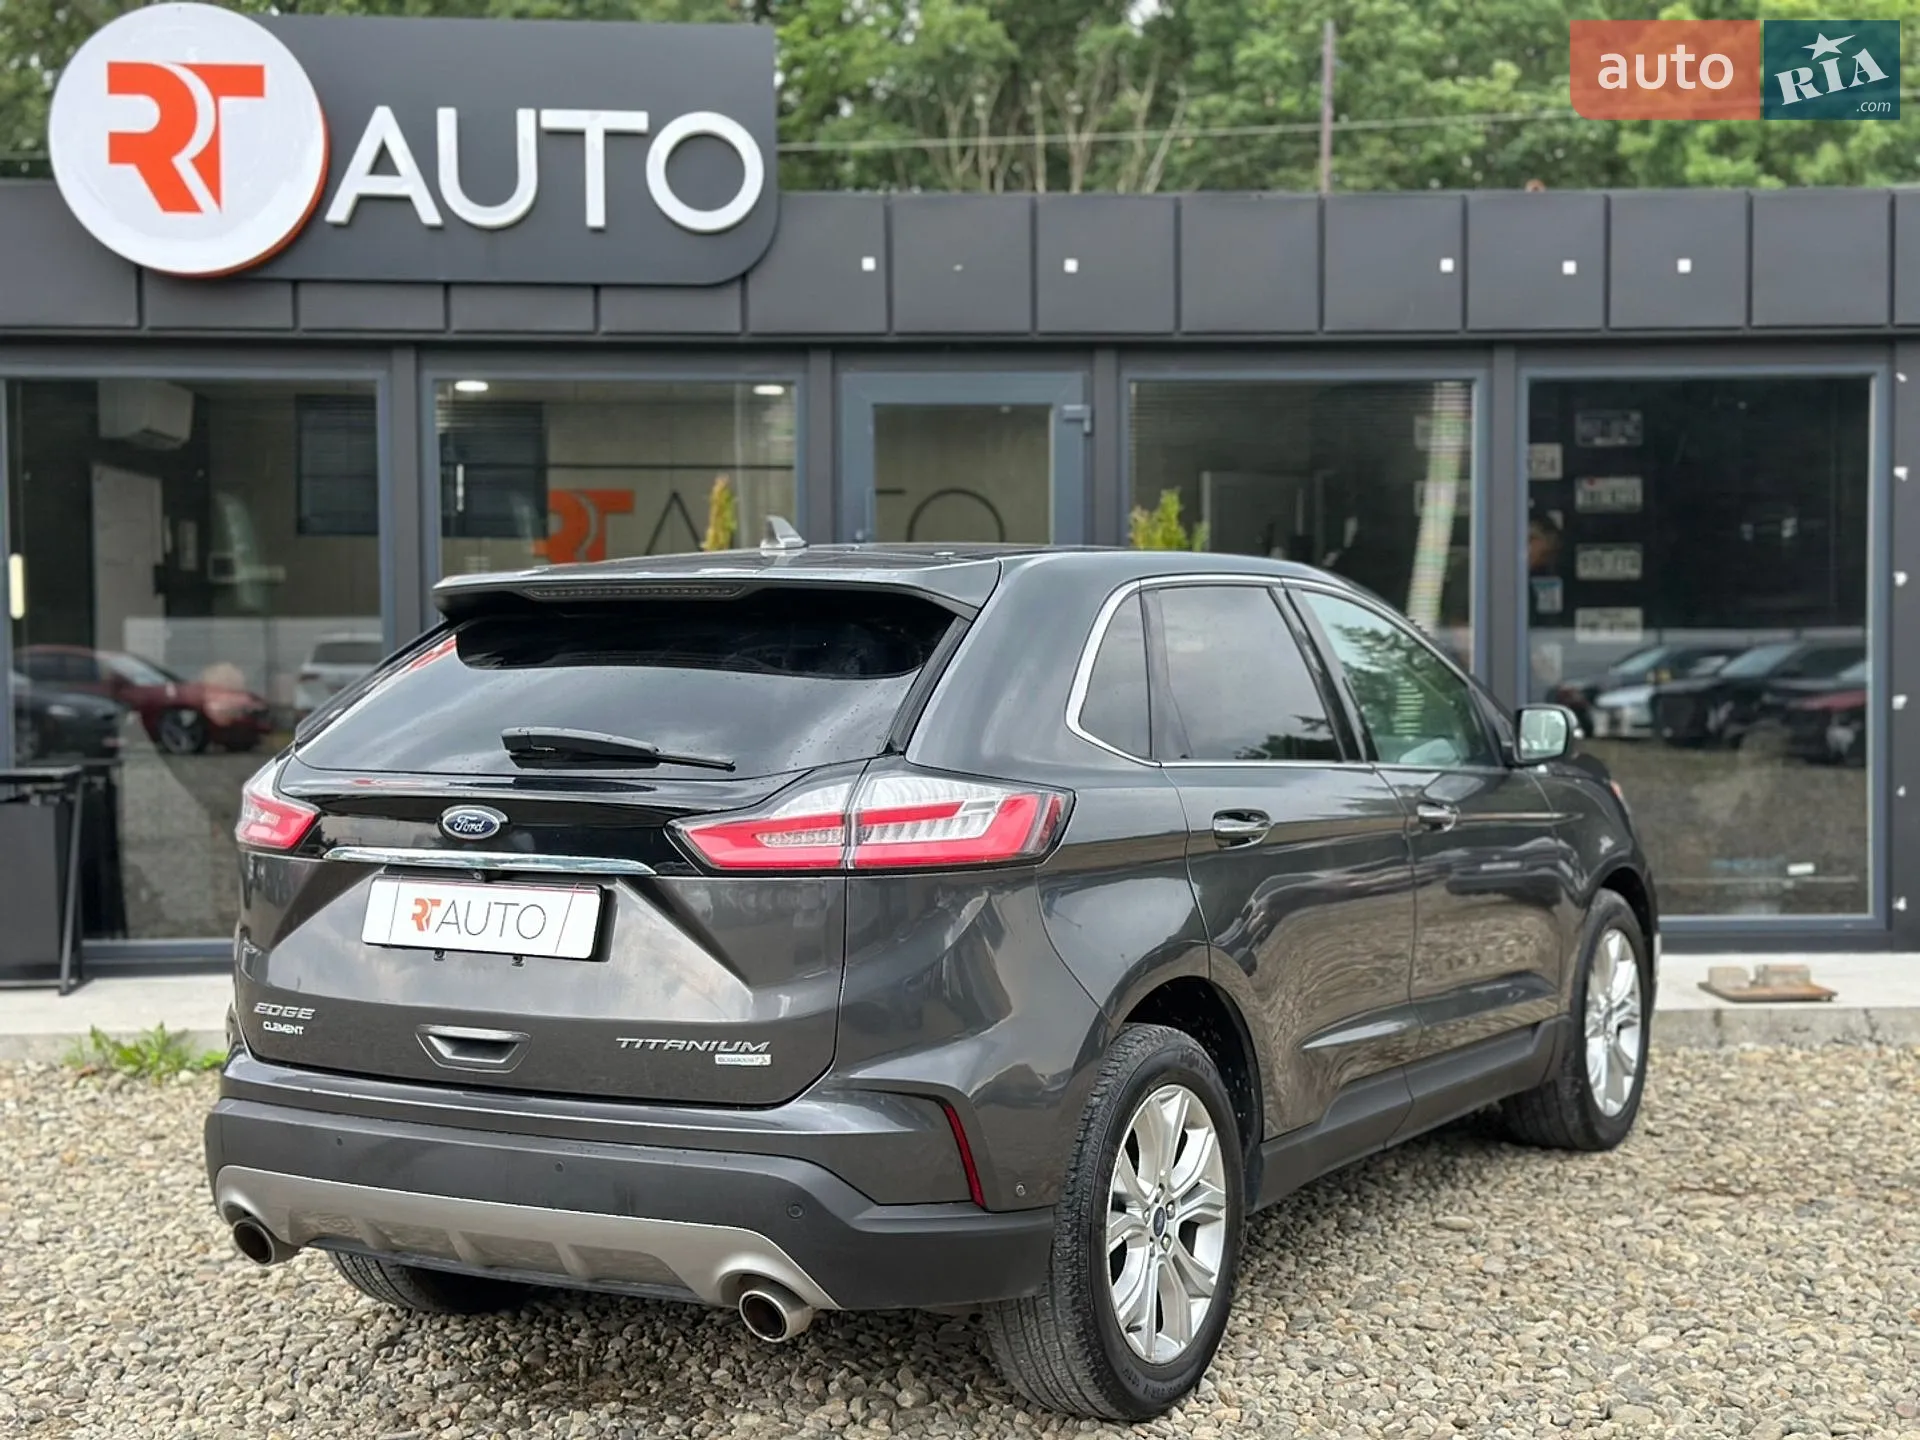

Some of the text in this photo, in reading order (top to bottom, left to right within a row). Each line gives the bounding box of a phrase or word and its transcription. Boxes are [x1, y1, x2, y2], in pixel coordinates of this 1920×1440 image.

[107, 61, 764, 233] RT AUTO
[453, 814, 487, 833] Ford
[435, 899, 547, 940] AUTO
[253, 1002, 316, 1020] EDGE
[615, 1037, 771, 1053] TITANIUM
